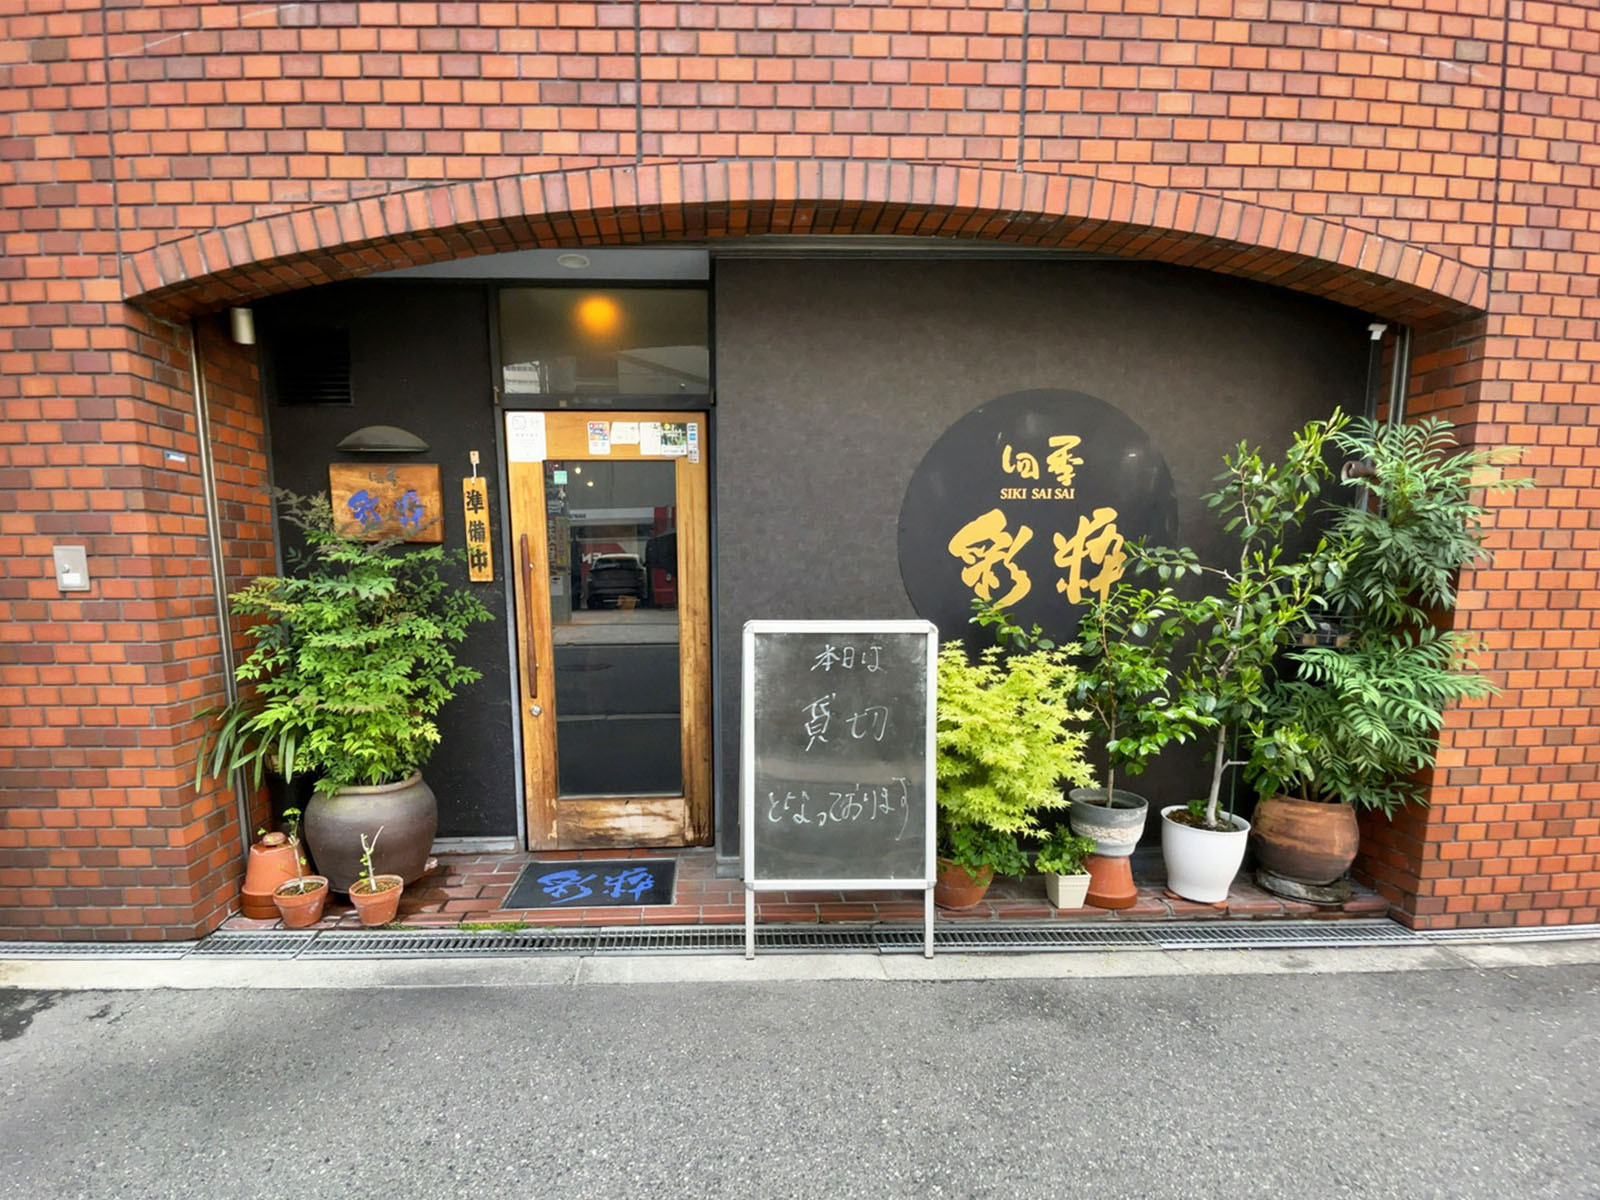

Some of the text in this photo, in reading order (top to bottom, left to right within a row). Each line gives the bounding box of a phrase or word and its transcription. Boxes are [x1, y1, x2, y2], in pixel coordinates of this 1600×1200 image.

[1000, 487, 1075, 500] SIKI SAI SAI
[465, 489, 489, 573] 準備中
[811, 644, 887, 672] 本日は
[801, 692, 889, 752] 貸切
[767, 777, 910, 842] となっております
